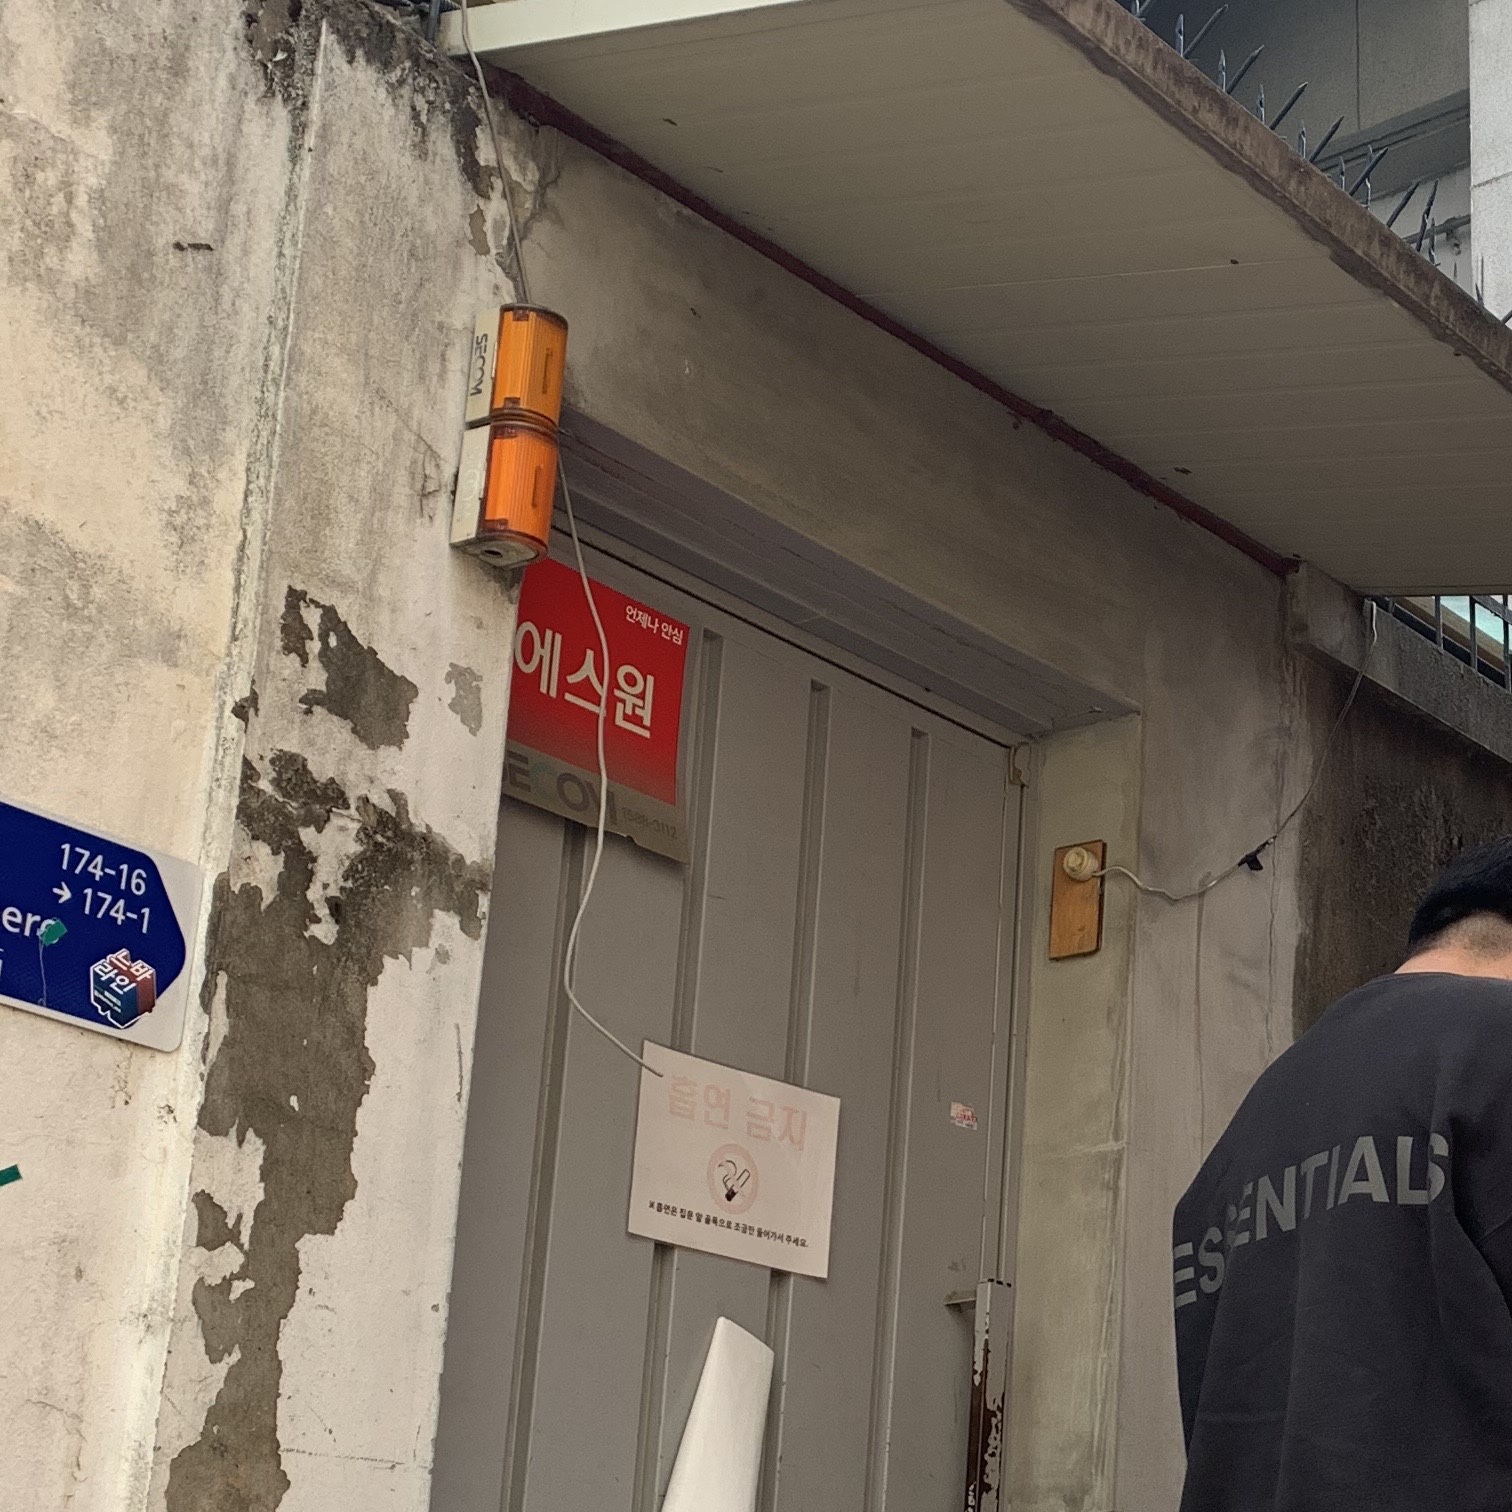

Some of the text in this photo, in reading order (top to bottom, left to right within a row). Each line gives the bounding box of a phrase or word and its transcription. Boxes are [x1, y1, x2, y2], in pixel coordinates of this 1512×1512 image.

[470, 333, 488, 397] SECOM
[626, 605, 684, 646] 언제나 안심
[514, 621, 655, 739] 에스원
[502, 750, 618, 826] ECOM
[61, 843, 147, 895] 174-16
[83, 888, 150, 933] 174-1
[746, 1097, 808, 1152] 금지
